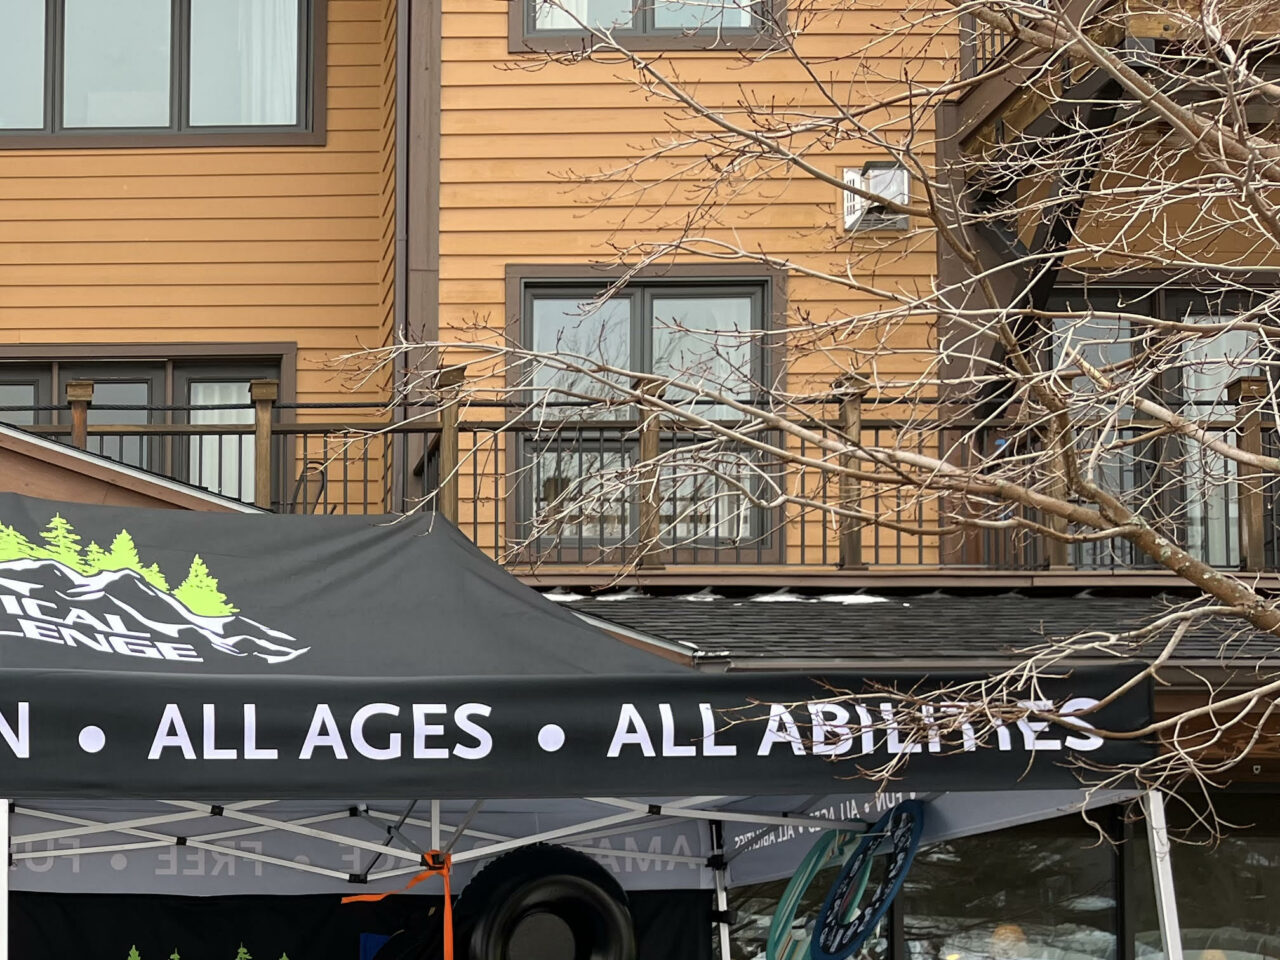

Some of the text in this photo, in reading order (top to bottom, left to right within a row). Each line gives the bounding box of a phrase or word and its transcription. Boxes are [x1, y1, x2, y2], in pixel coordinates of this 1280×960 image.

[147, 703, 279, 760] ALL
[298, 702, 493, 761] AGES
[607, 703, 741, 758] ALL
